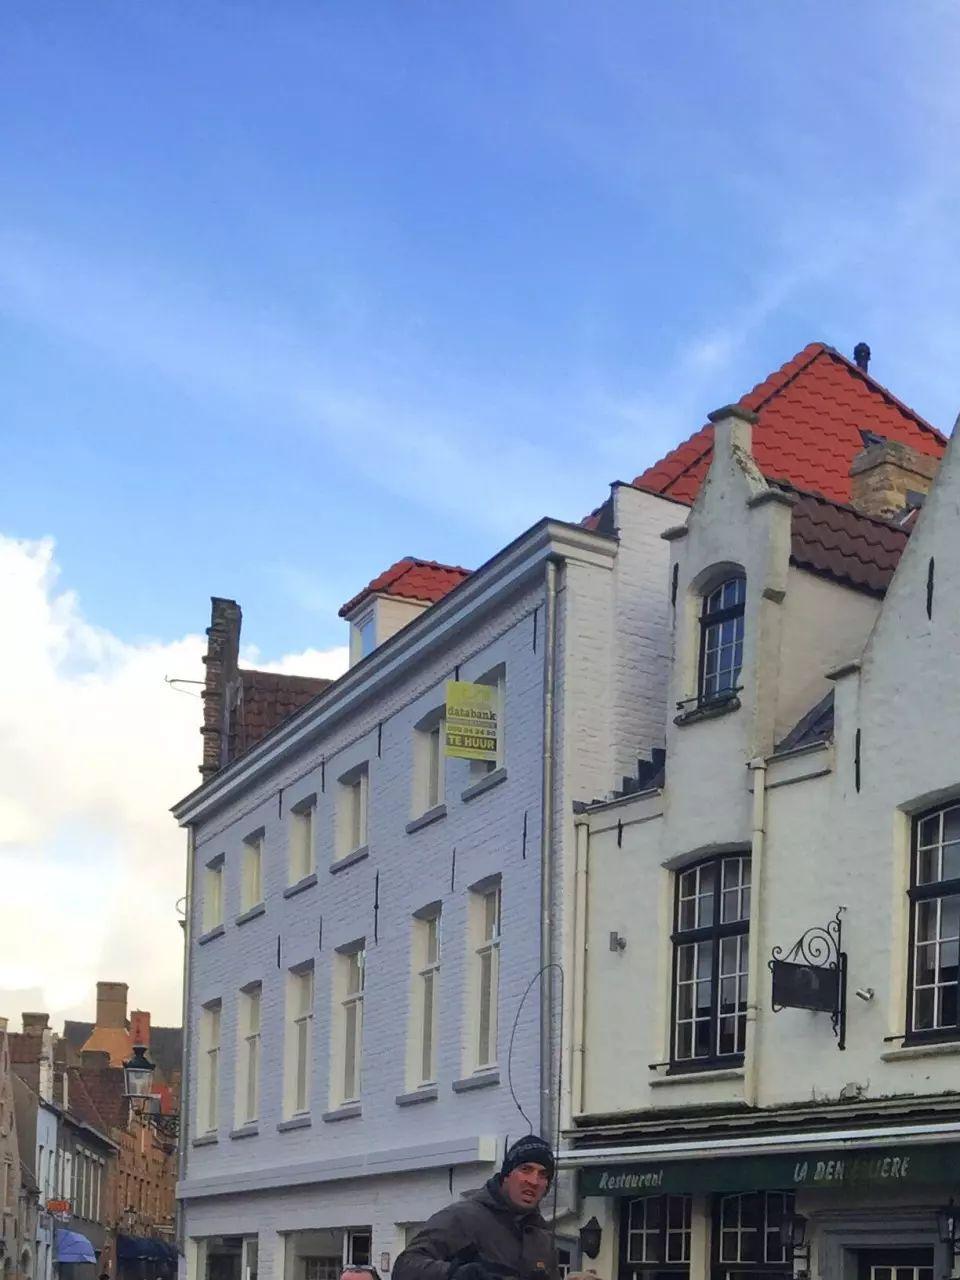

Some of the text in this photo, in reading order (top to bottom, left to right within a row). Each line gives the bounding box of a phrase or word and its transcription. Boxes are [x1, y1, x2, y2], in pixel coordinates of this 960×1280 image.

[448, 734, 495, 749] TE HUUR
[599, 1169, 663, 1189] Restaurant
[794, 1161, 808, 1182] LA
